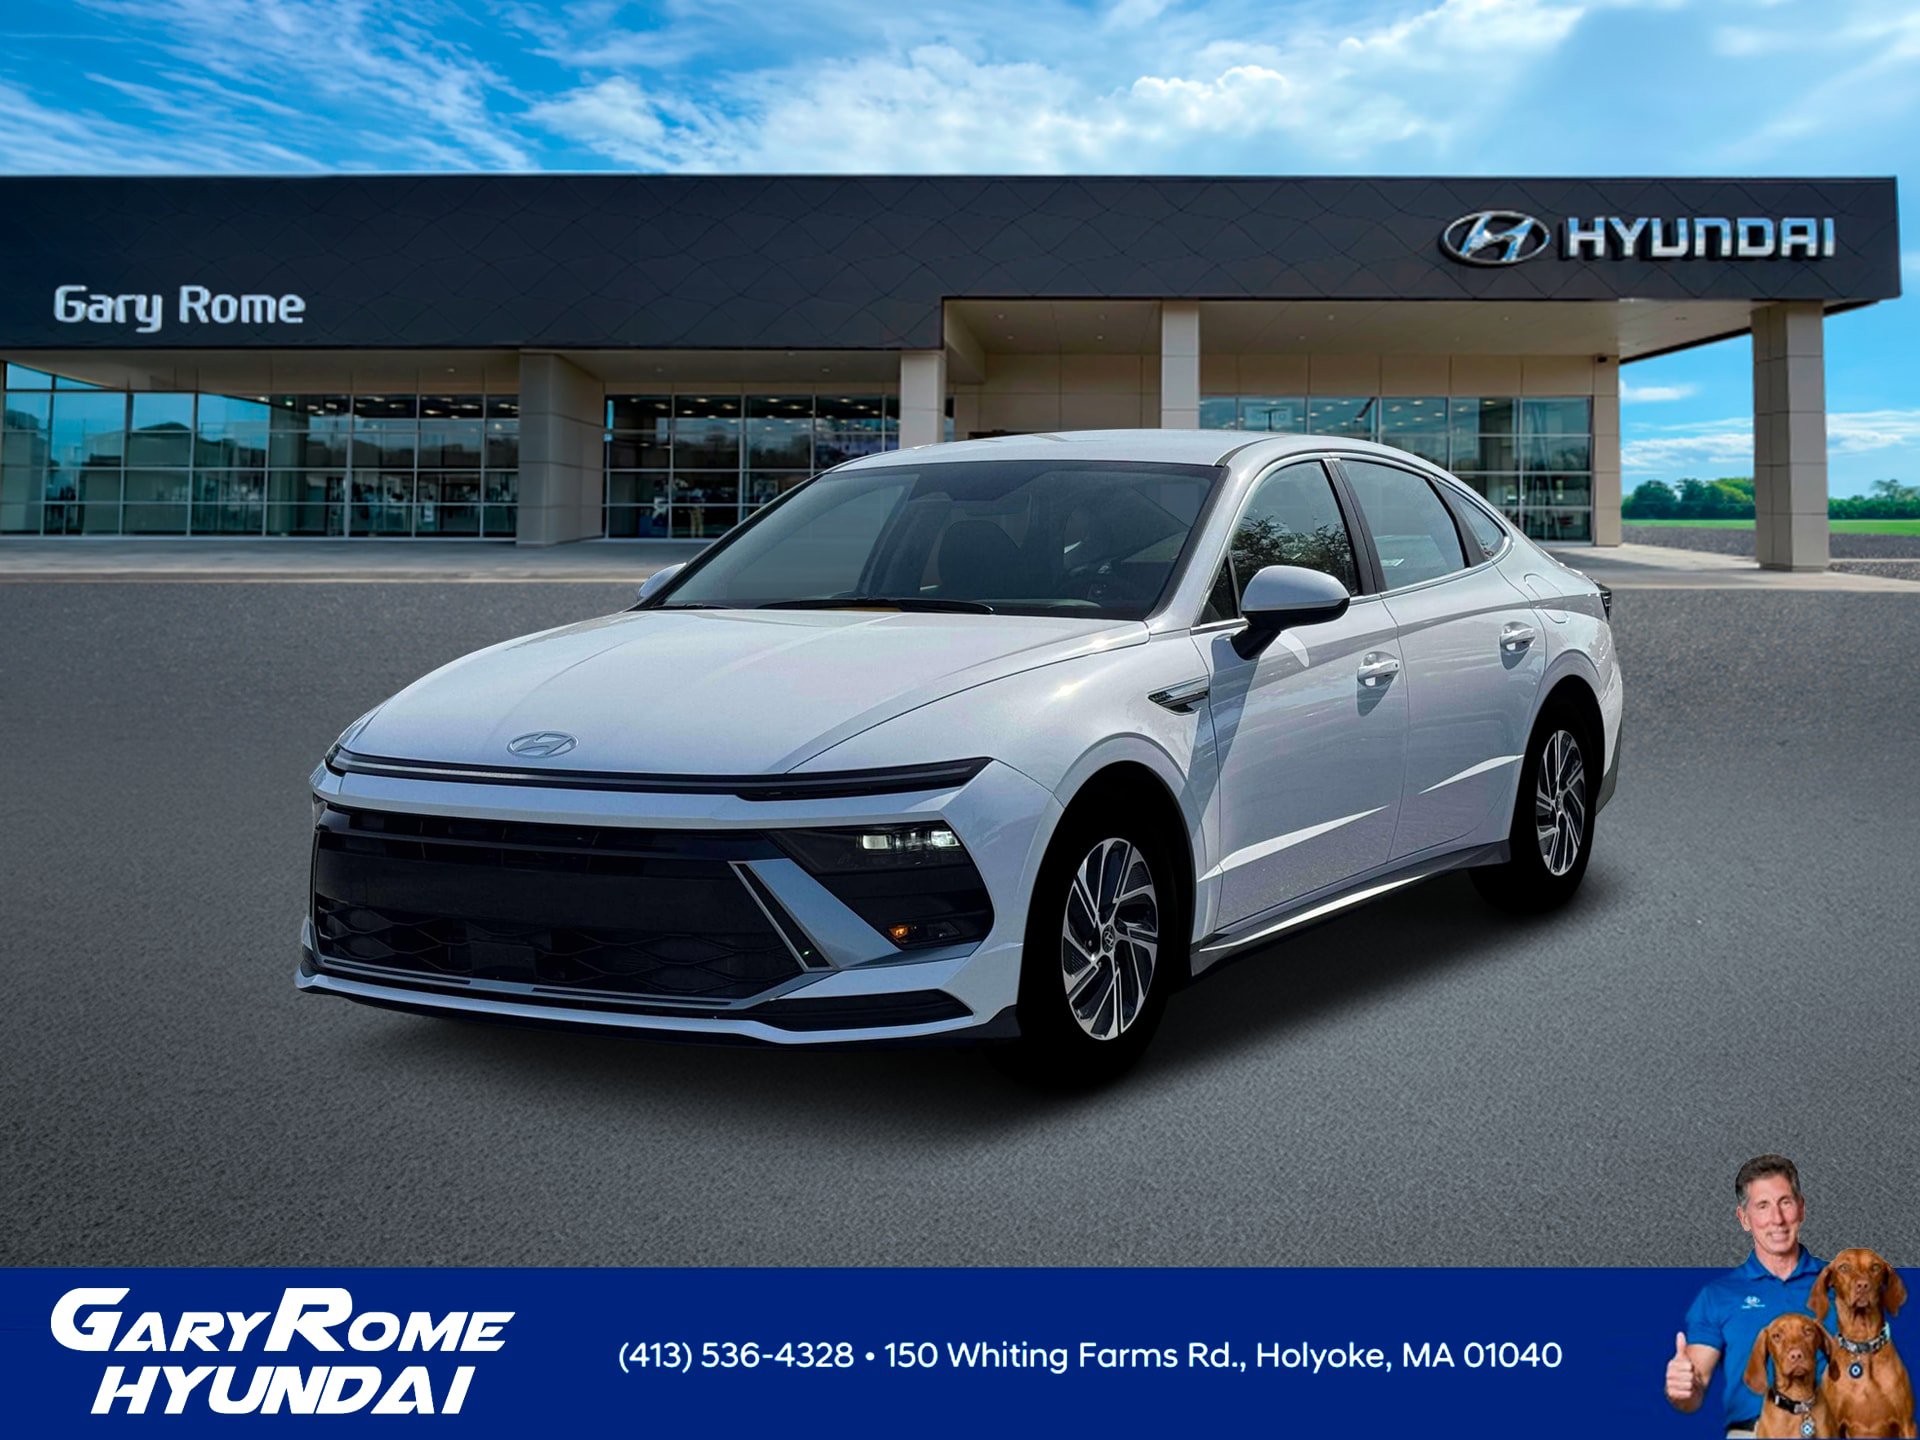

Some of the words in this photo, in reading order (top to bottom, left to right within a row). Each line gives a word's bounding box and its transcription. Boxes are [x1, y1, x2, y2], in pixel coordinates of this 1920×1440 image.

[1567, 216, 1836, 257] HYUNDAI
[54, 285, 163, 333] Gary
[179, 285, 306, 324] Rome
